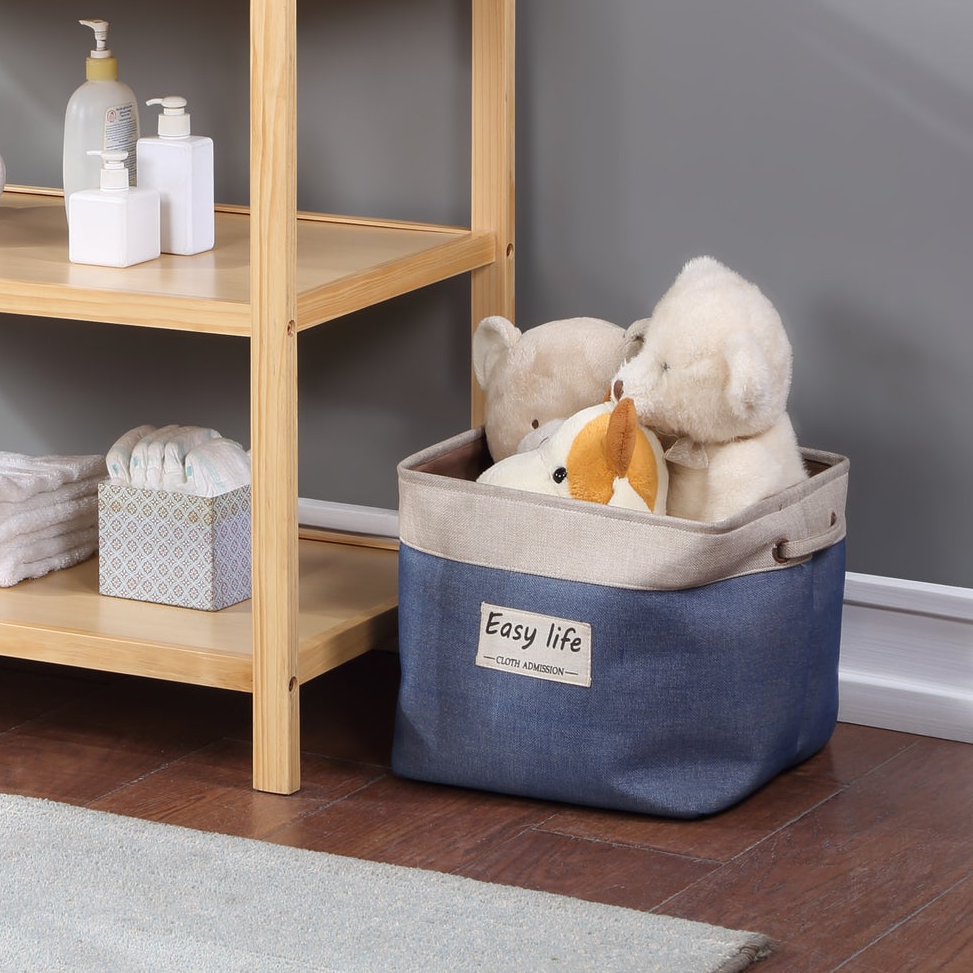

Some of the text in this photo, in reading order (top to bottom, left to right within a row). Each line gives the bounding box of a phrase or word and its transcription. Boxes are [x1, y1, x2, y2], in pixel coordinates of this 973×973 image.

[485, 611, 582, 653] Easy life
[495, 655, 565, 676] CLOTH ADMISSION
